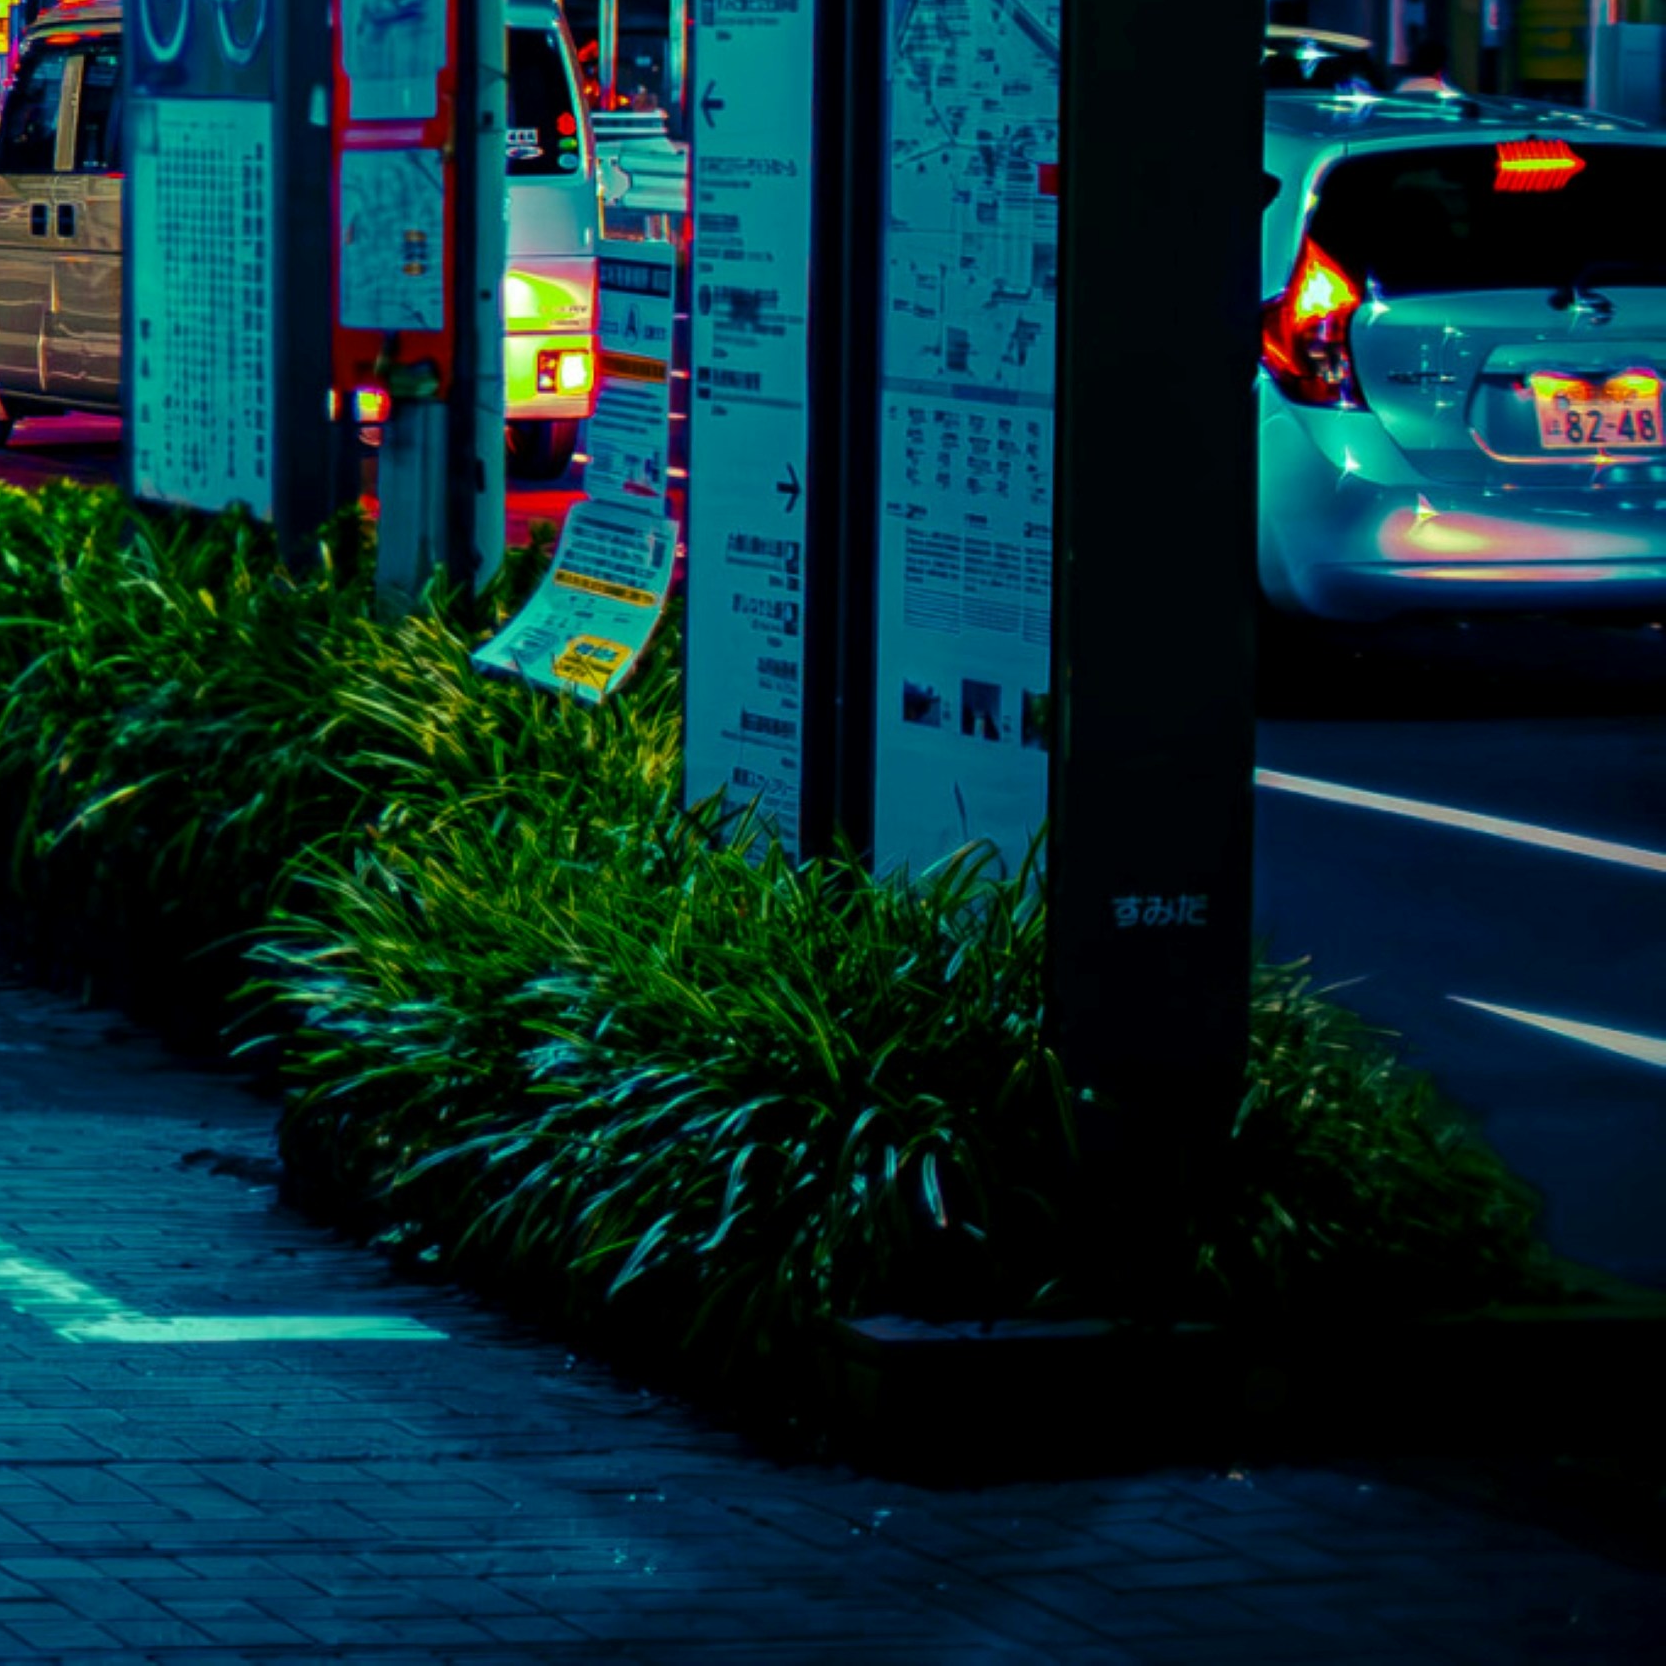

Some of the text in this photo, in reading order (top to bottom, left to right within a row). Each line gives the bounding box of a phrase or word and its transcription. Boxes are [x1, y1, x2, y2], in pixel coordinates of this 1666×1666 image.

[1567, 409, 1657, 443] 82-48
[1110, 892, 1210, 929] すみだ
